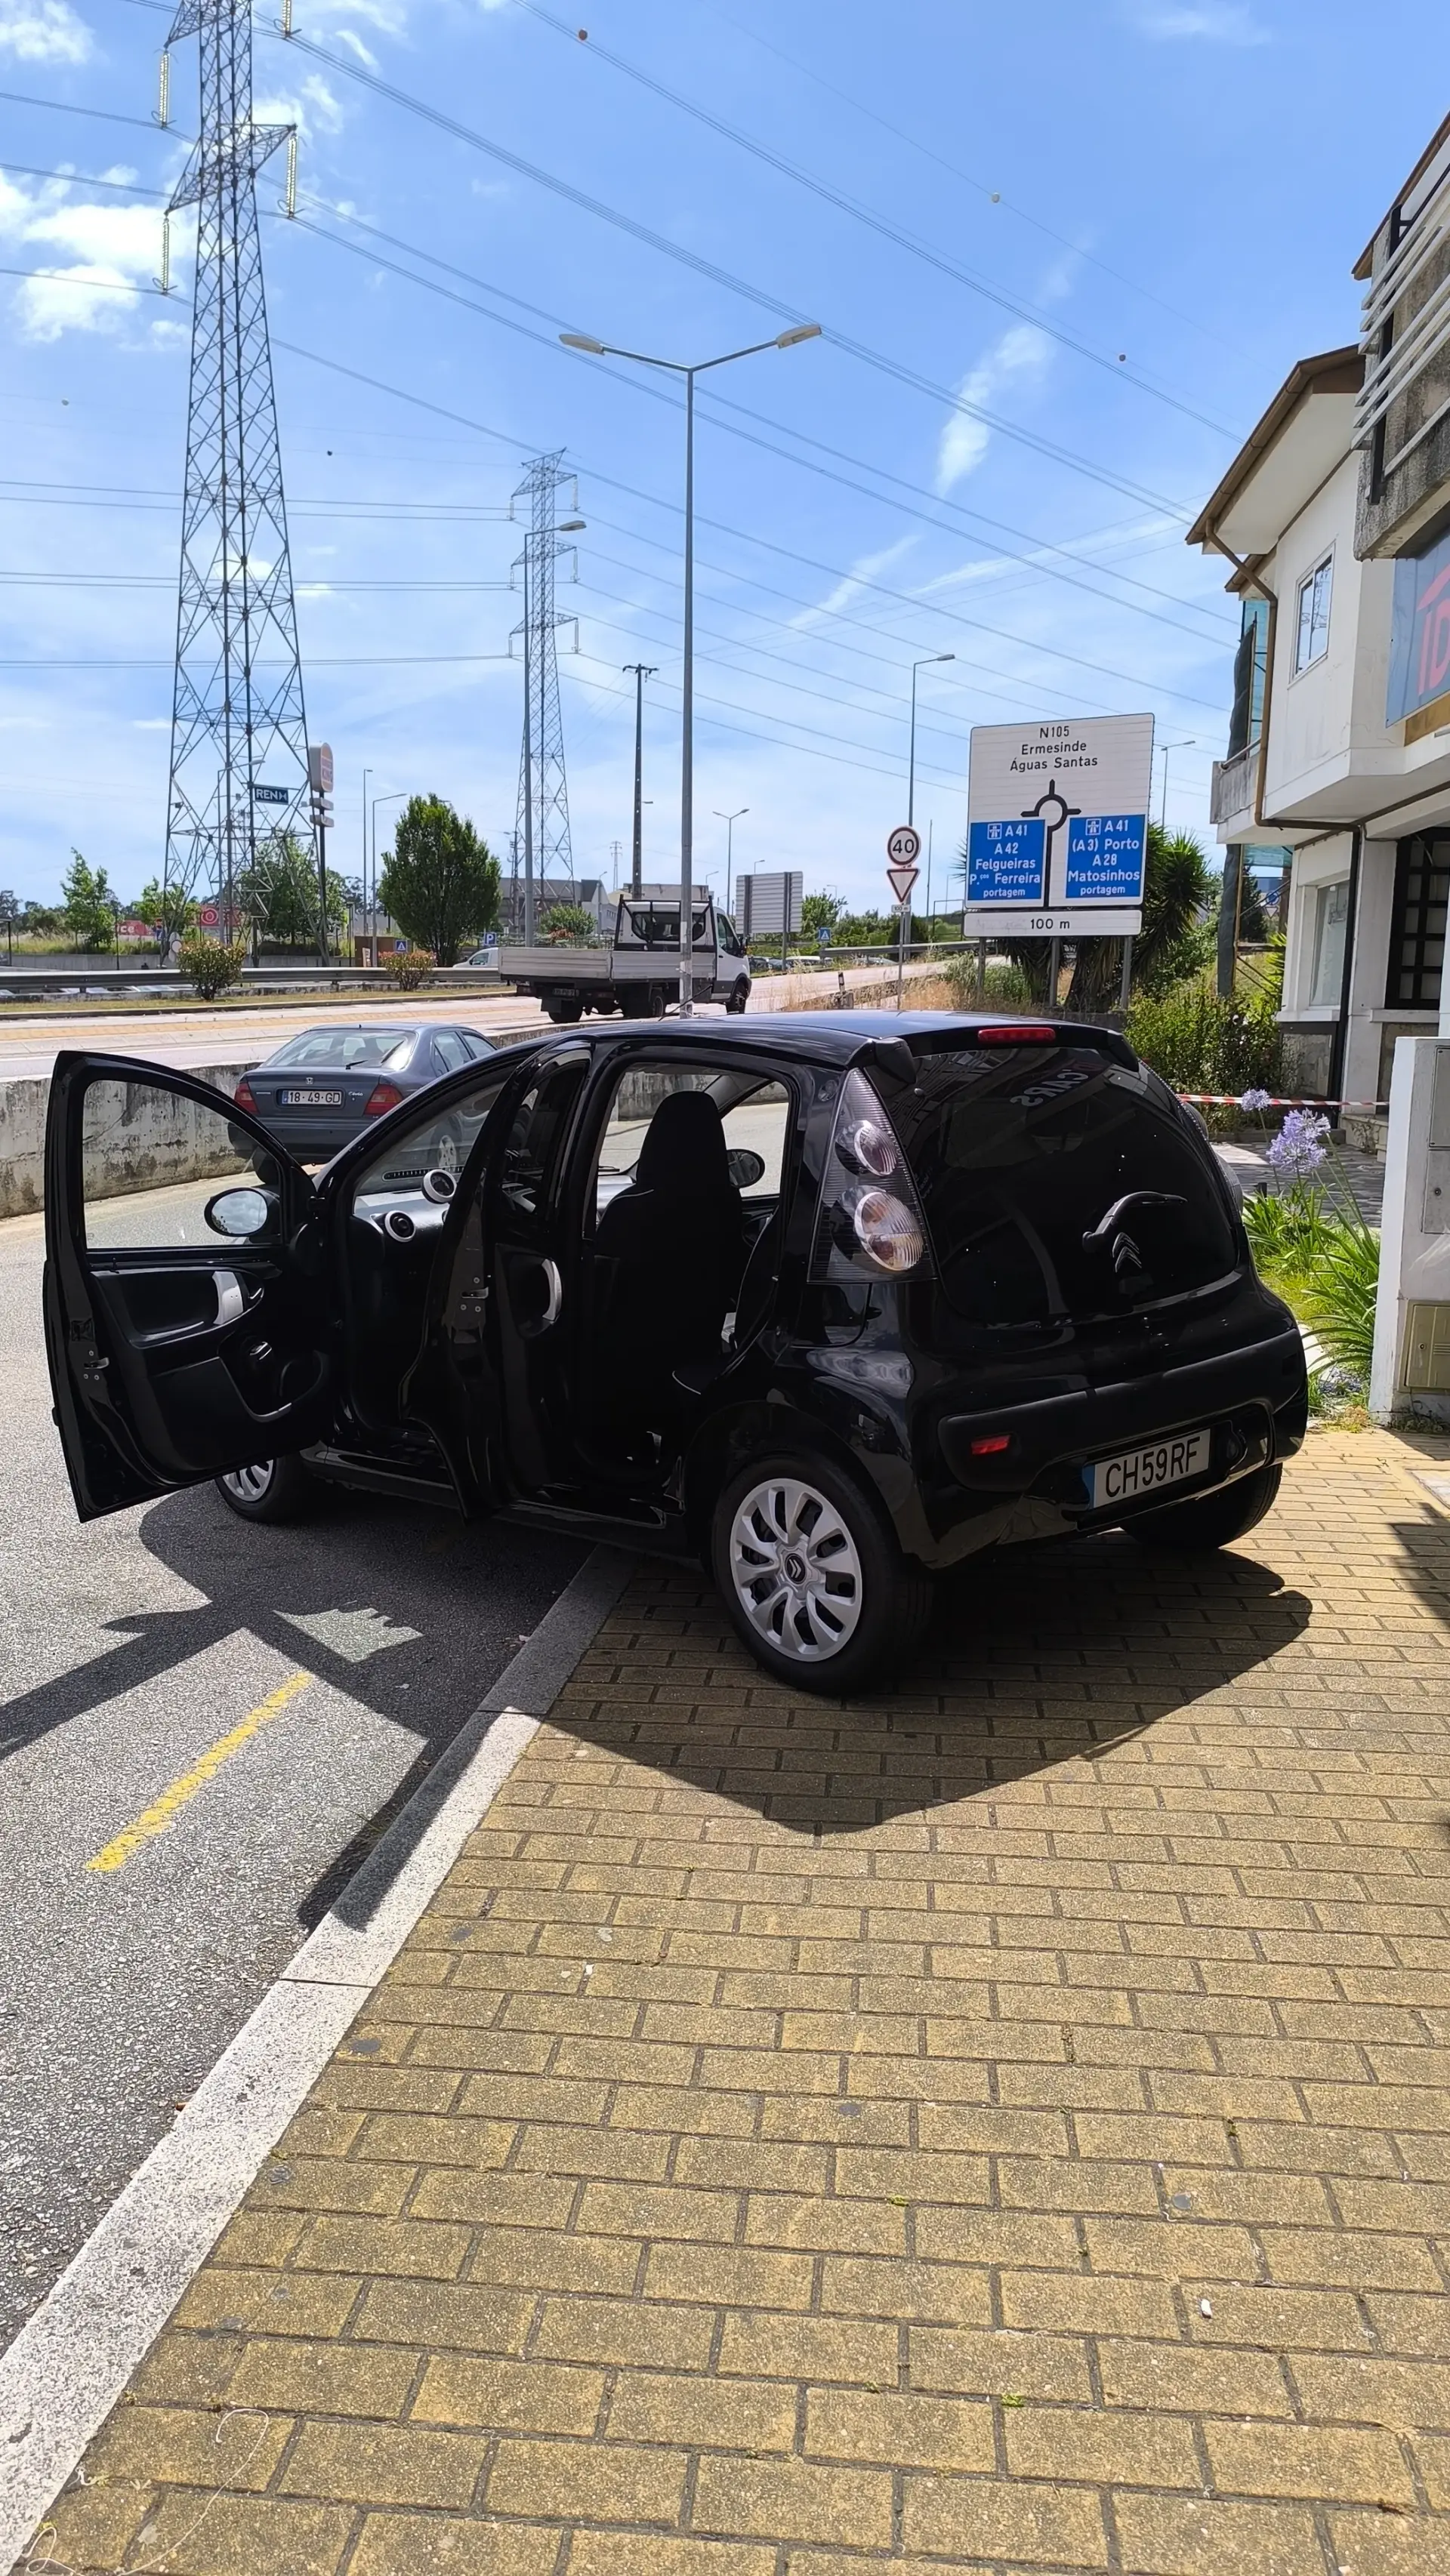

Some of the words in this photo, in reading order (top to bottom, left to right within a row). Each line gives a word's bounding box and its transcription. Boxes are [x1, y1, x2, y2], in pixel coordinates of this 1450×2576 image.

[1039, 726, 1070, 739] N105
[1021, 741, 1088, 755] Ermesinde
[1010, 757, 1048, 773] Águas
[1054, 756, 1099, 769] Santas
[256, 788, 279, 800] REN
[893, 839, 915, 854] 40
[1104, 837, 1140, 851] Porto
[975, 857, 1036, 872] Felgueiras
[995, 871, 1041, 885] Ferreira
[1067, 868, 1140, 883] Matosinhos
[983, 888, 1026, 898] portagem
[1080, 885, 1126, 896] portagem
[1030, 918, 1054, 929] 100
[1060, 920, 1070, 929] m
[486, 933, 494, 944] P
[1105, 1436, 1201, 1498] CH59RF
